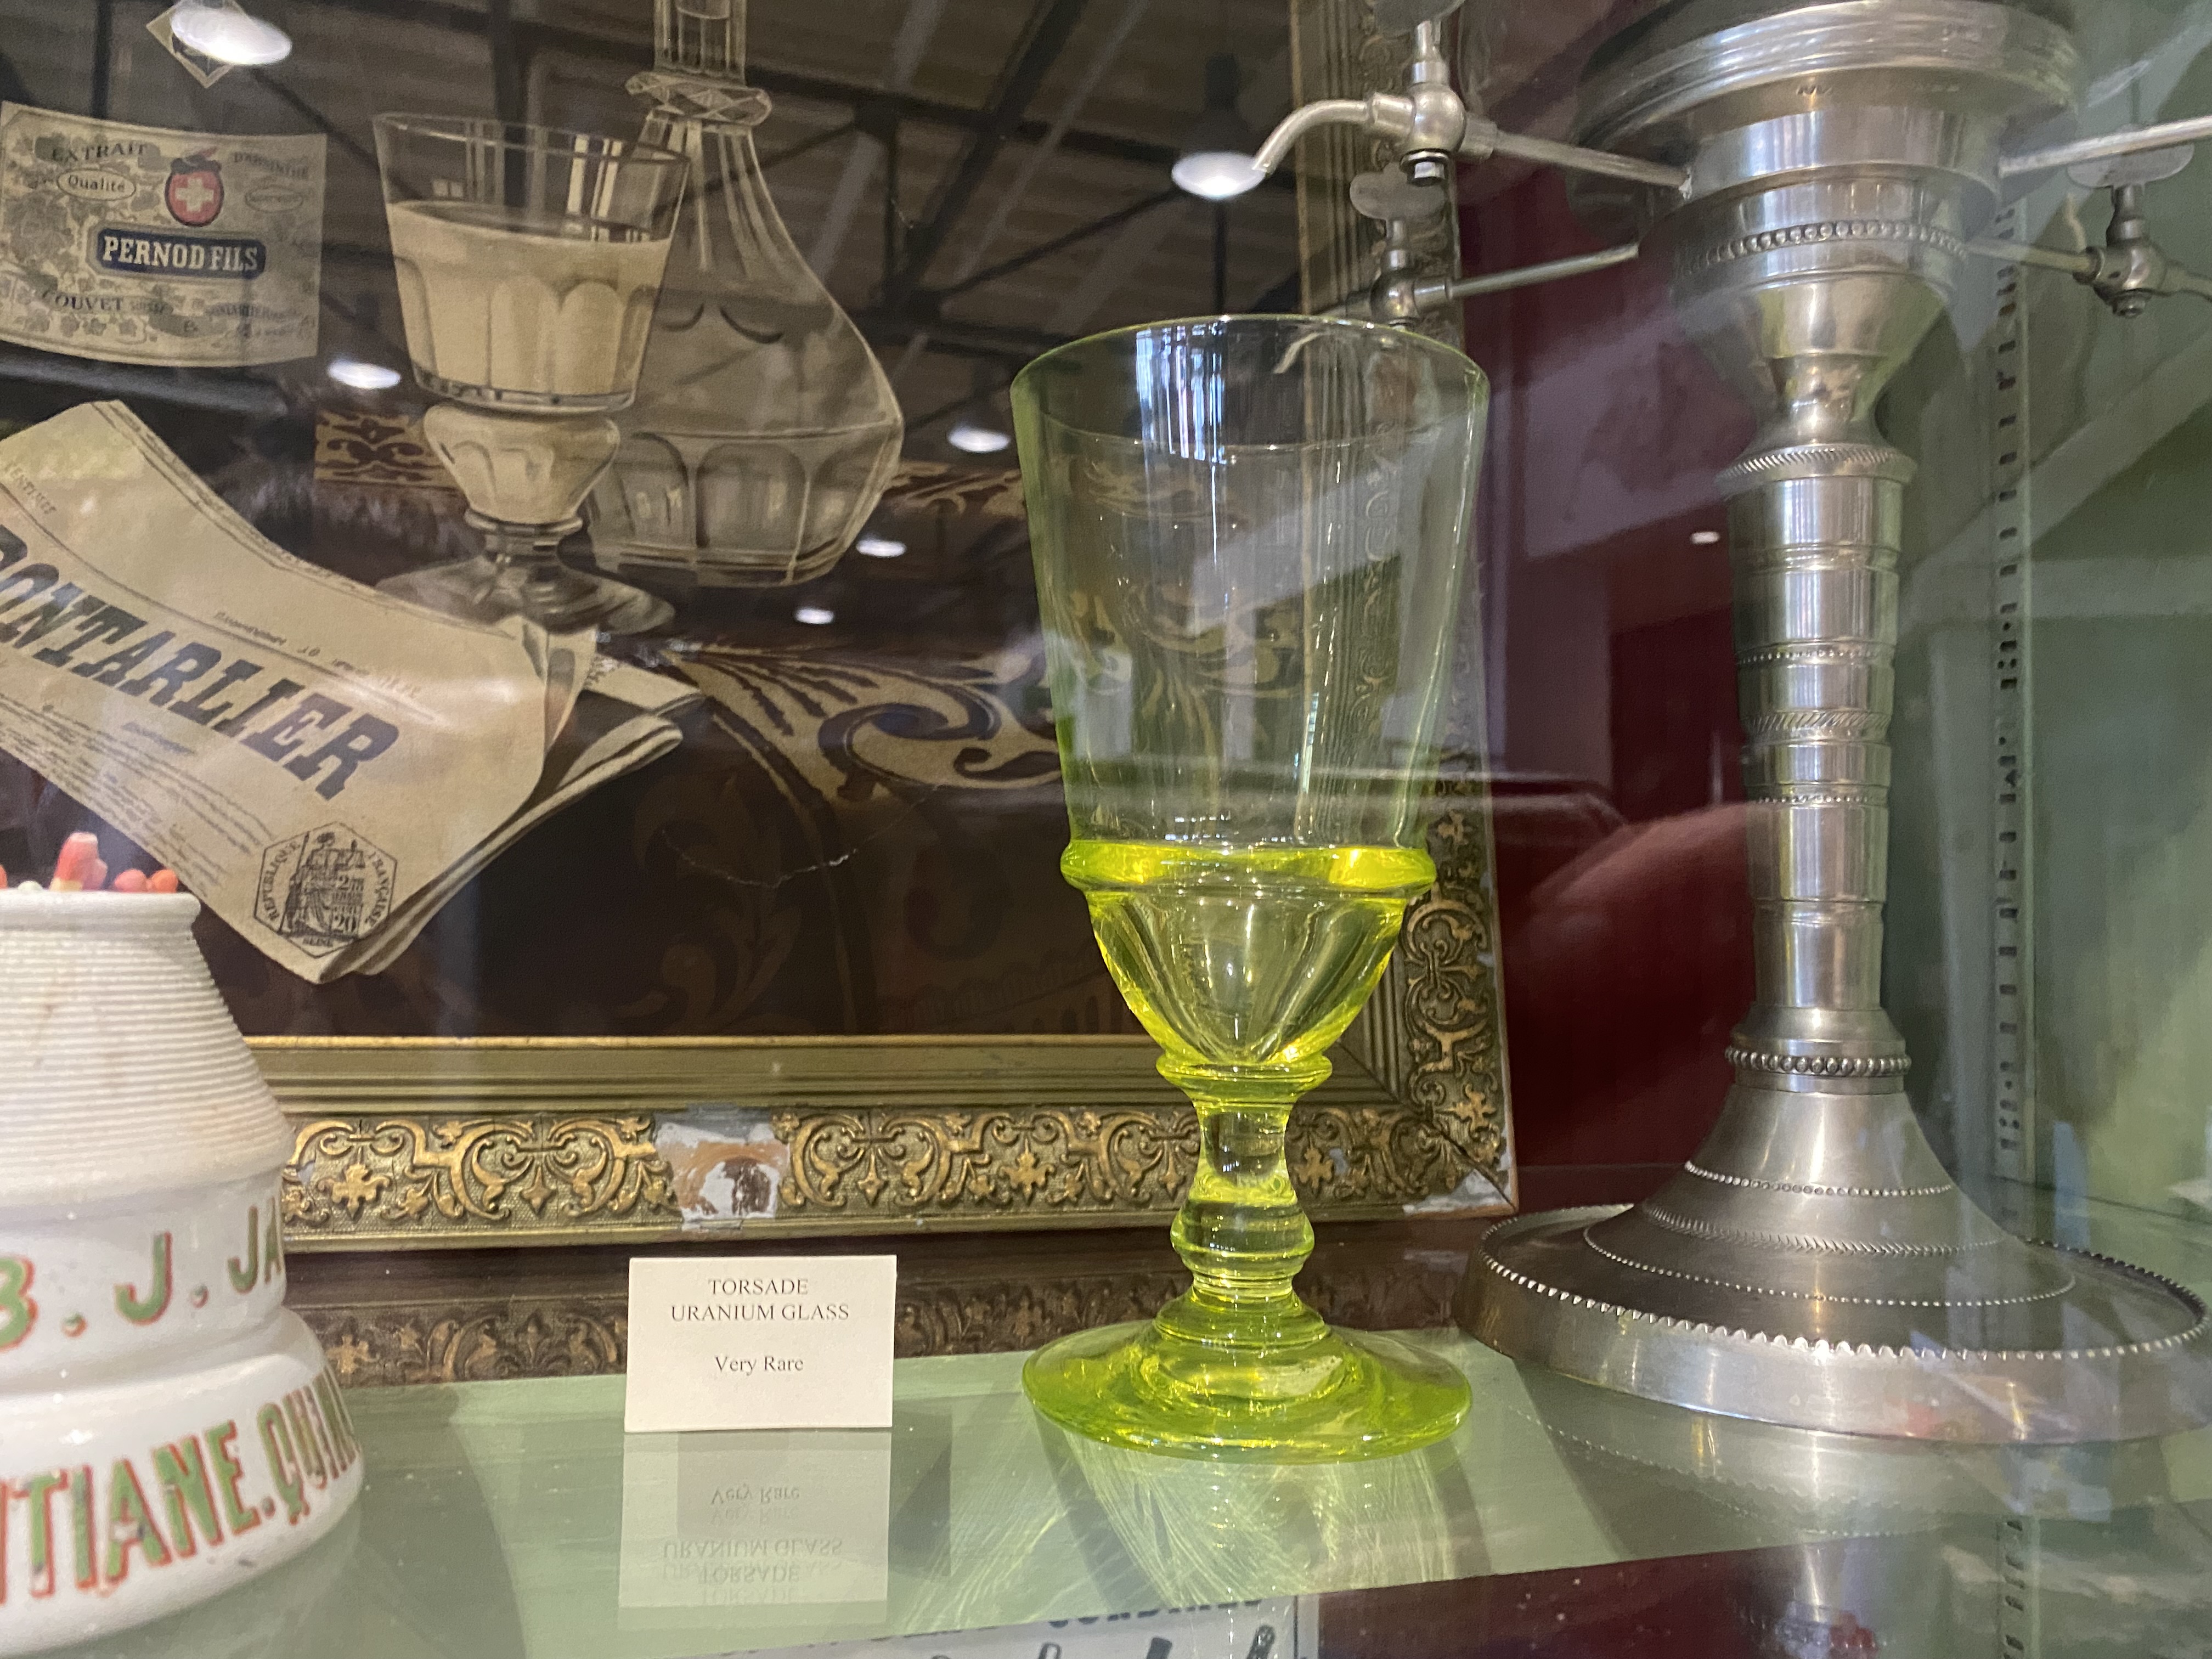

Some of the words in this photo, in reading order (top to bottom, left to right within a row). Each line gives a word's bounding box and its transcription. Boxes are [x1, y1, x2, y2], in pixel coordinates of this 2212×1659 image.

[103, 236, 205, 270] PERNOD
[210, 246, 258, 272] FILS
[0, 524, 399, 800] ONTARLIER
[708, 1279, 809, 1295] TORSADE
[671, 1304, 774, 1322] URANIUM
[781, 1304, 850, 1321] GLASS
[715, 1355, 757, 1376] Very
[763, 1355, 804, 1371] Rare
